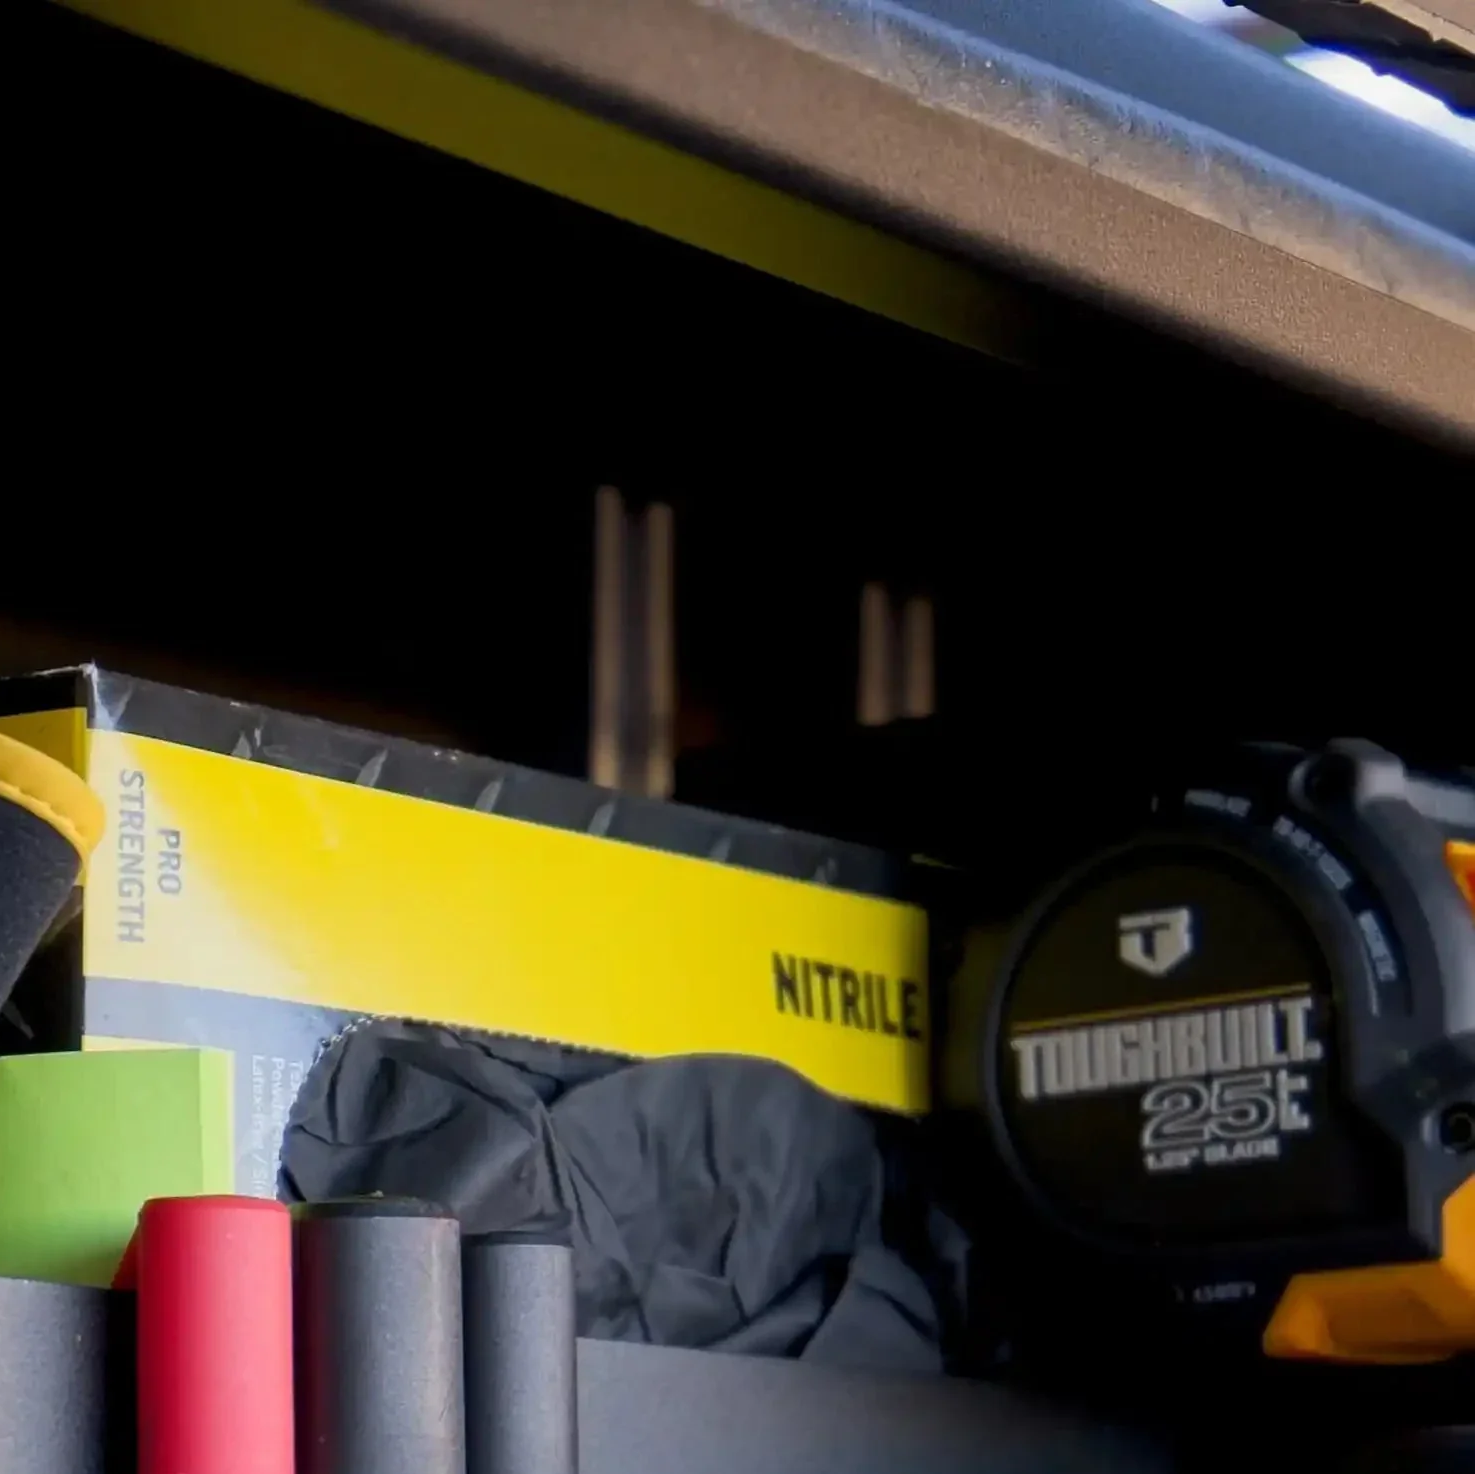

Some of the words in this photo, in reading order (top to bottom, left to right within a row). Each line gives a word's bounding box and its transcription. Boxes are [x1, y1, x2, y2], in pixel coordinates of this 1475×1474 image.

[117, 768, 145, 944] STRENGTH
[156, 828, 182, 895] PRO
[771, 950, 923, 1041] NITRILE
[1141, 1072, 1277, 1150] 25
